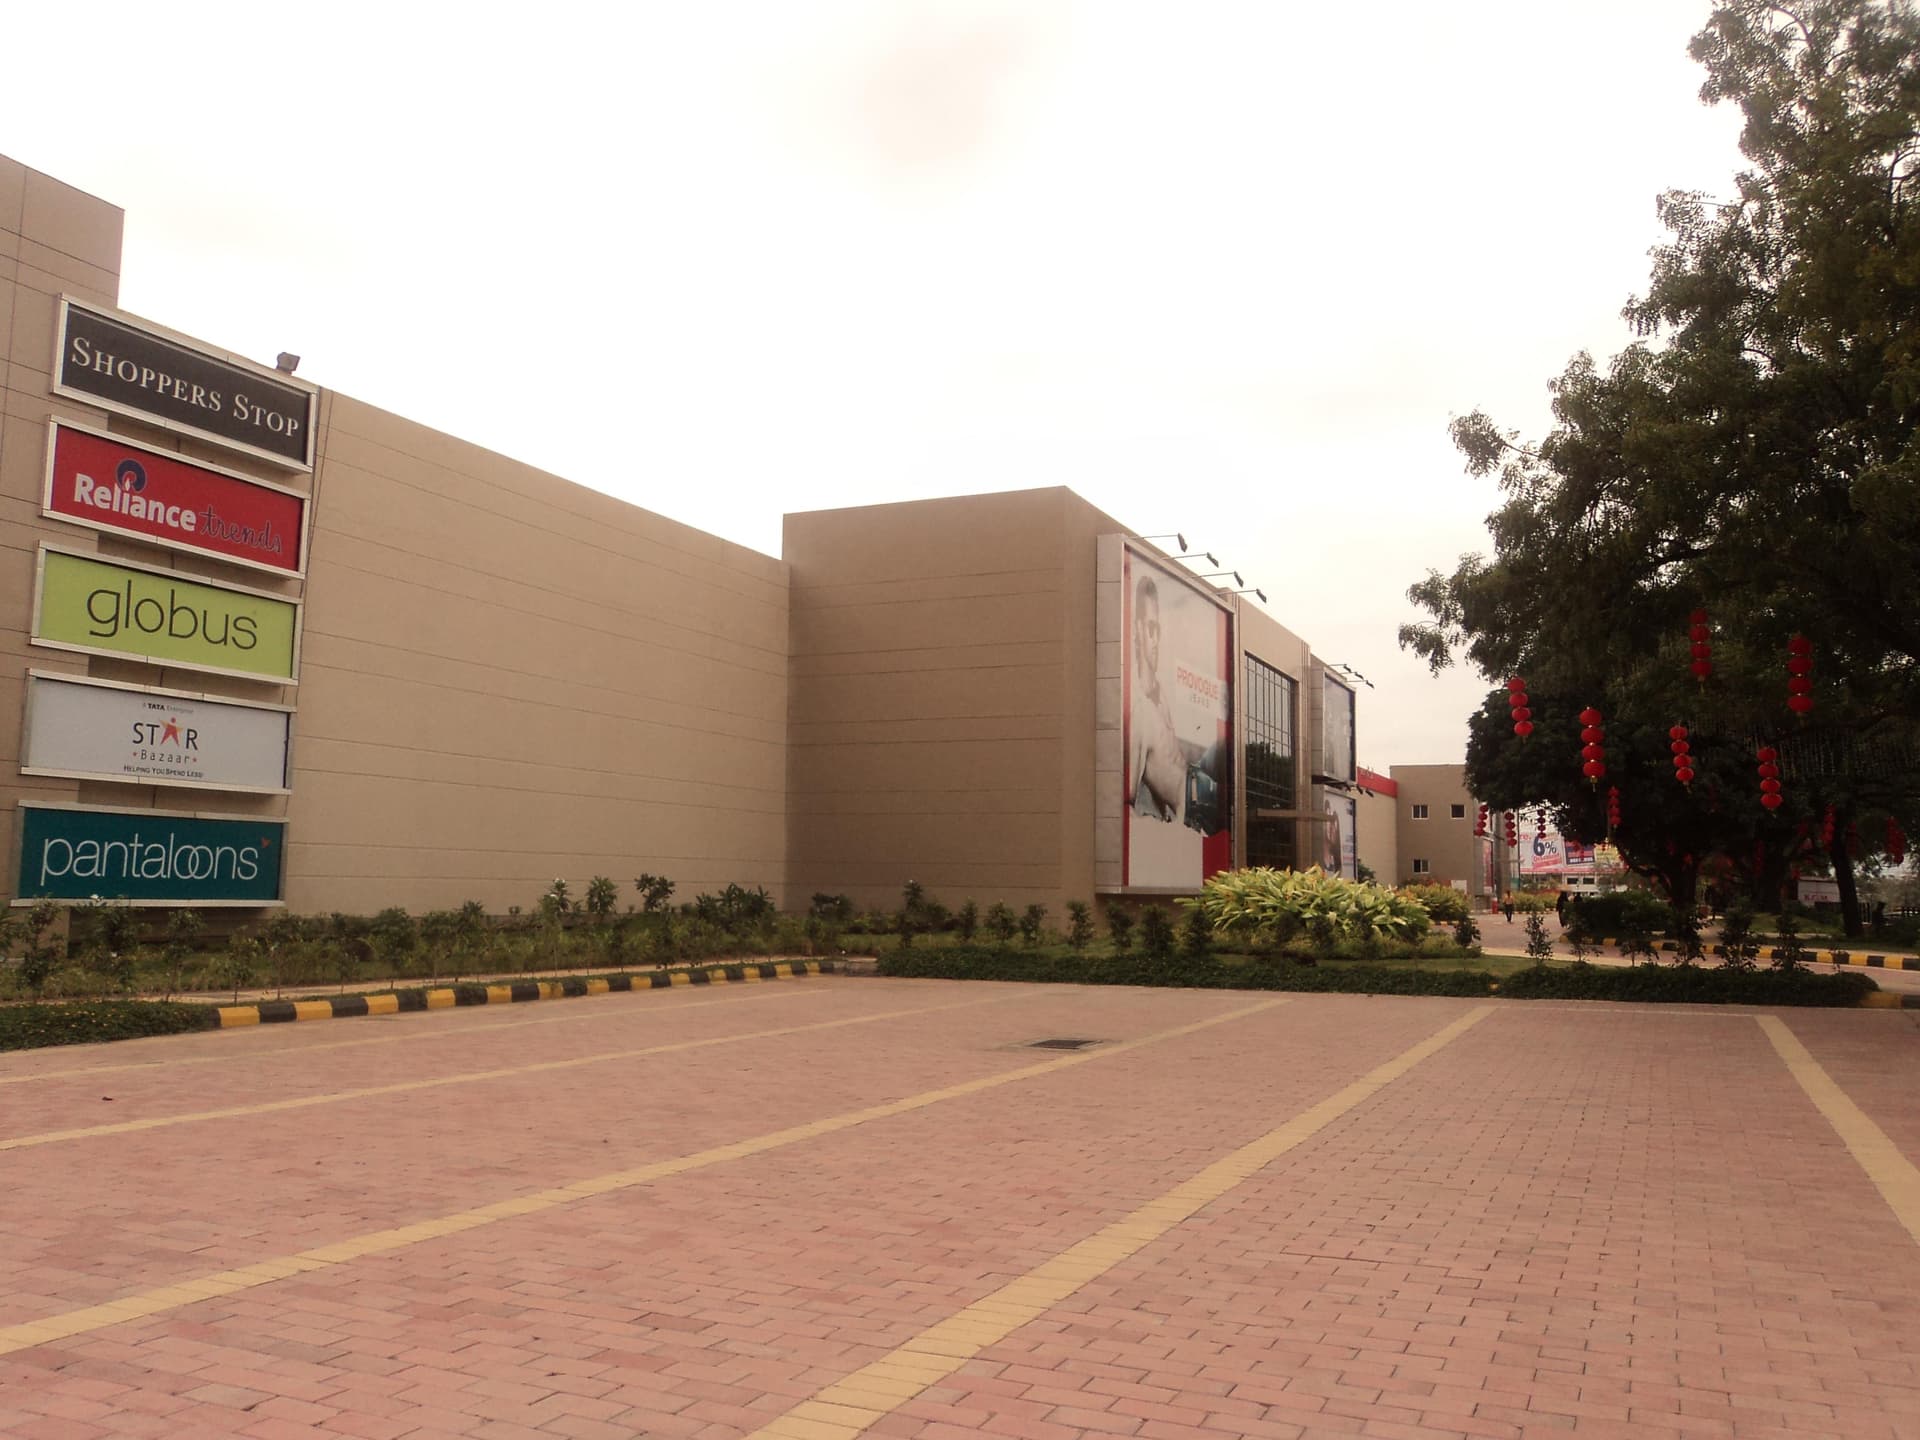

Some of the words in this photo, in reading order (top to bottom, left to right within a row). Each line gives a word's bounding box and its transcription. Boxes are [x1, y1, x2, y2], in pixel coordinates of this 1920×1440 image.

[72, 336, 221, 412] SHOPPERS
[233, 393, 299, 437] STOP
[74, 472, 197, 532] Reliance
[200, 504, 282, 553] trends
[87, 579, 257, 650] globus
[148, 703, 165, 711] TATA
[141, 749, 190, 764] Bazaar
[40, 832, 259, 887] pantaloons
